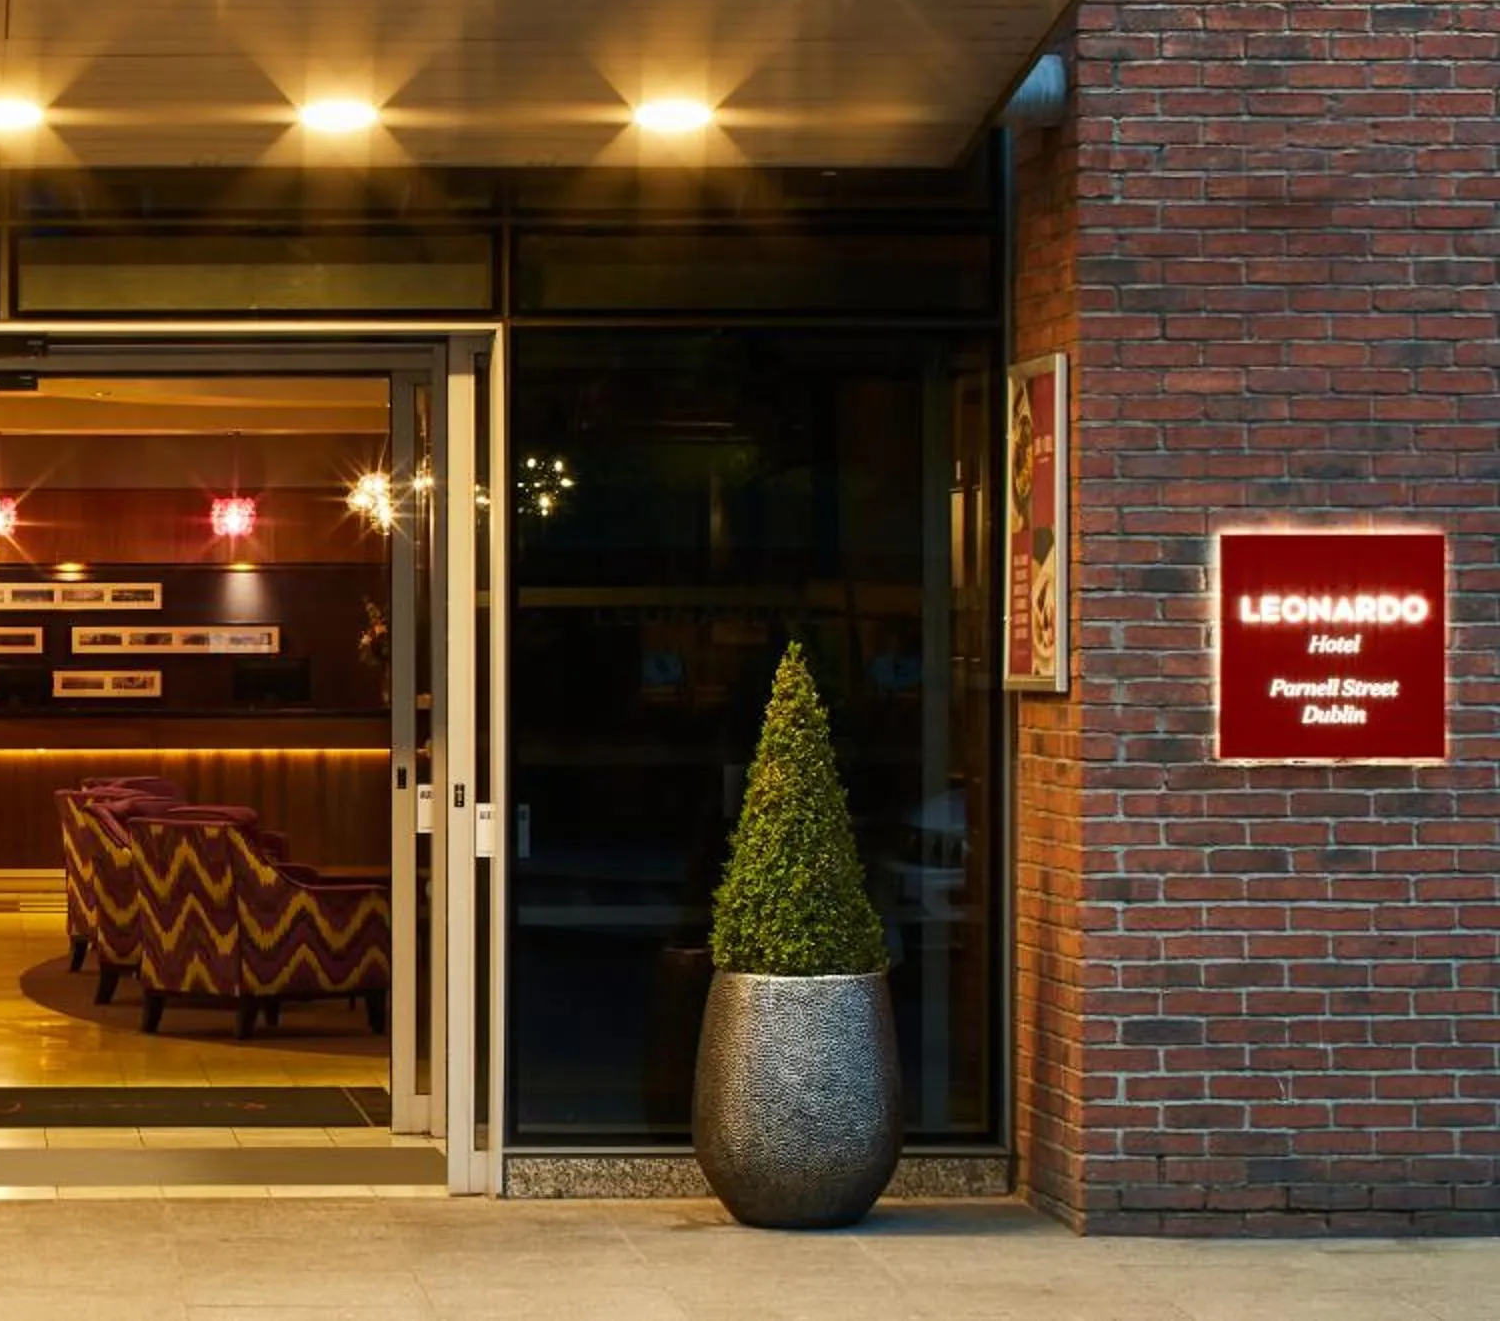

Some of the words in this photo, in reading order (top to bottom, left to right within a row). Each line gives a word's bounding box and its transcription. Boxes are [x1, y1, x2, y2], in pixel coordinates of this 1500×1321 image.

[1240, 595, 1429, 624] LEONARDO
[1308, 634, 1362, 654] Hotel
[1269, 678, 1340, 698] Parnell
[1342, 679, 1400, 698] Street
[1302, 705, 1368, 724] Dublin
